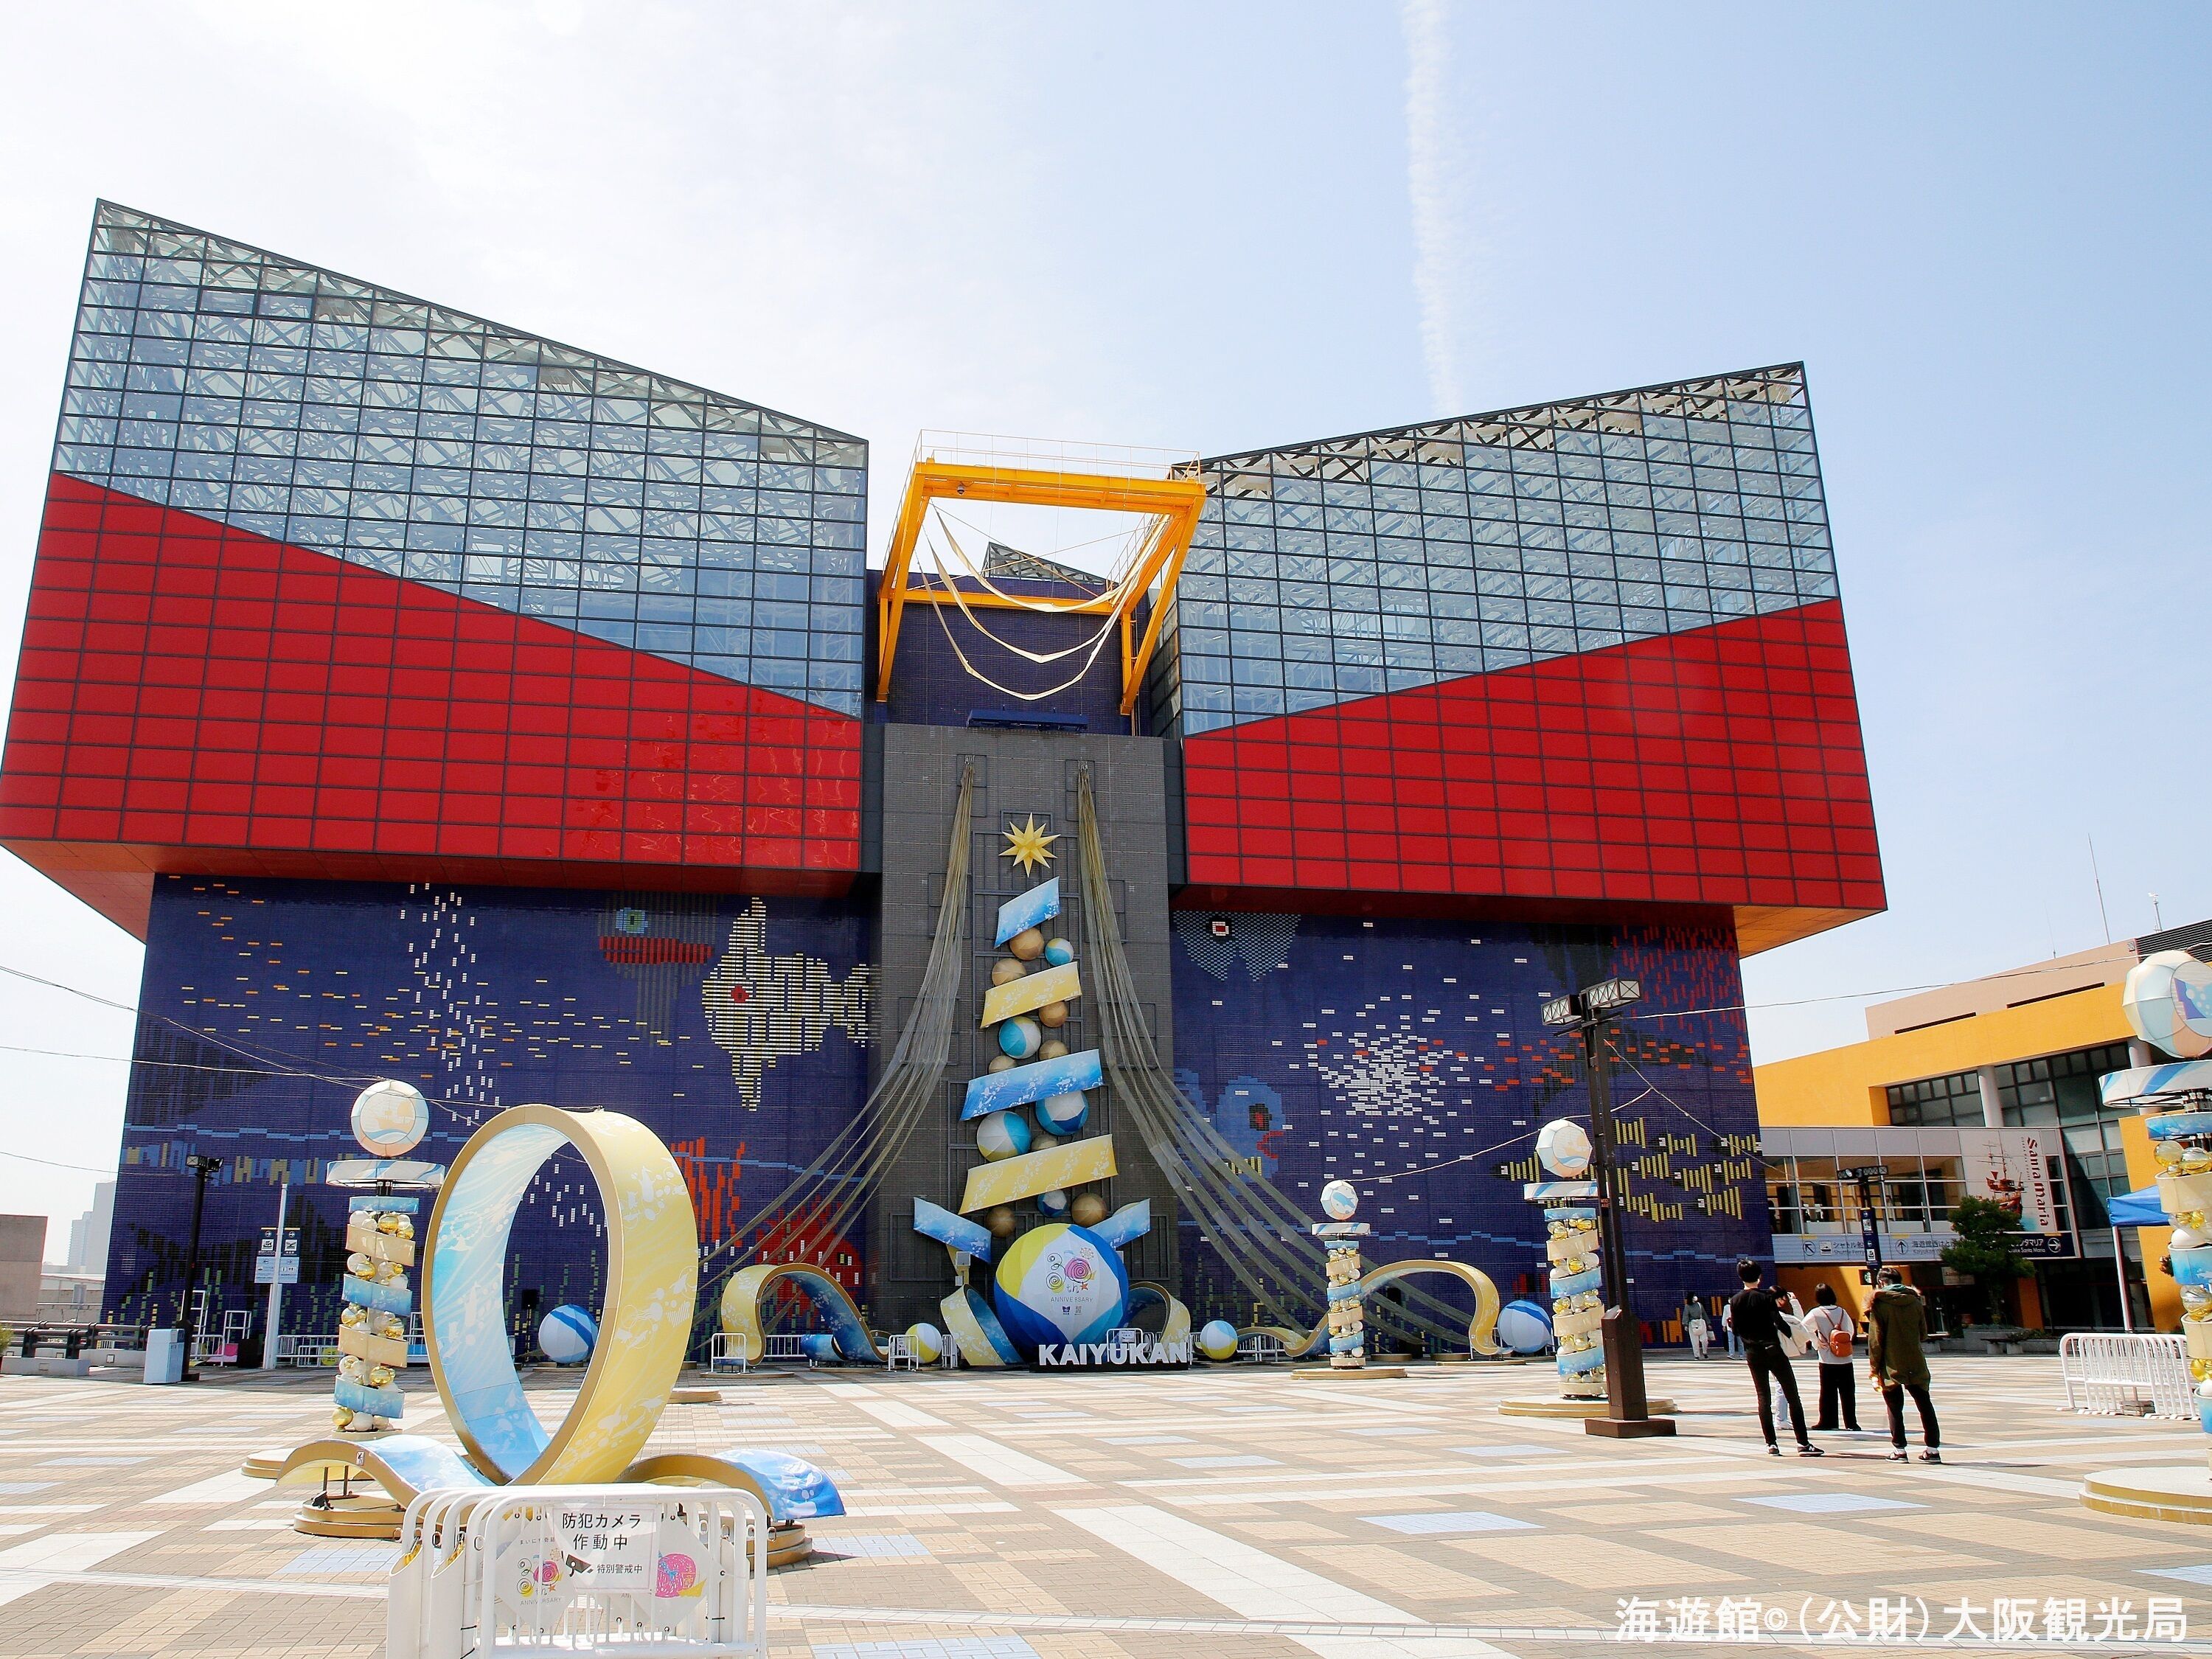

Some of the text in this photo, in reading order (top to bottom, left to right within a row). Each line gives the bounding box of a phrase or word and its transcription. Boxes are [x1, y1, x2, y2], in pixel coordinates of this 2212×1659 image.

[2027, 1136, 2041, 1179] Santa
[1039, 1342, 1188, 1366] KAIYUKAN
[562, 1512, 641, 1529] 防犯カメラ
[573, 1533, 628, 1551] 作動中
[597, 1563, 642, 1574] 特別警戒中
[520, 1596, 561, 1606] ANNIVRSARY
